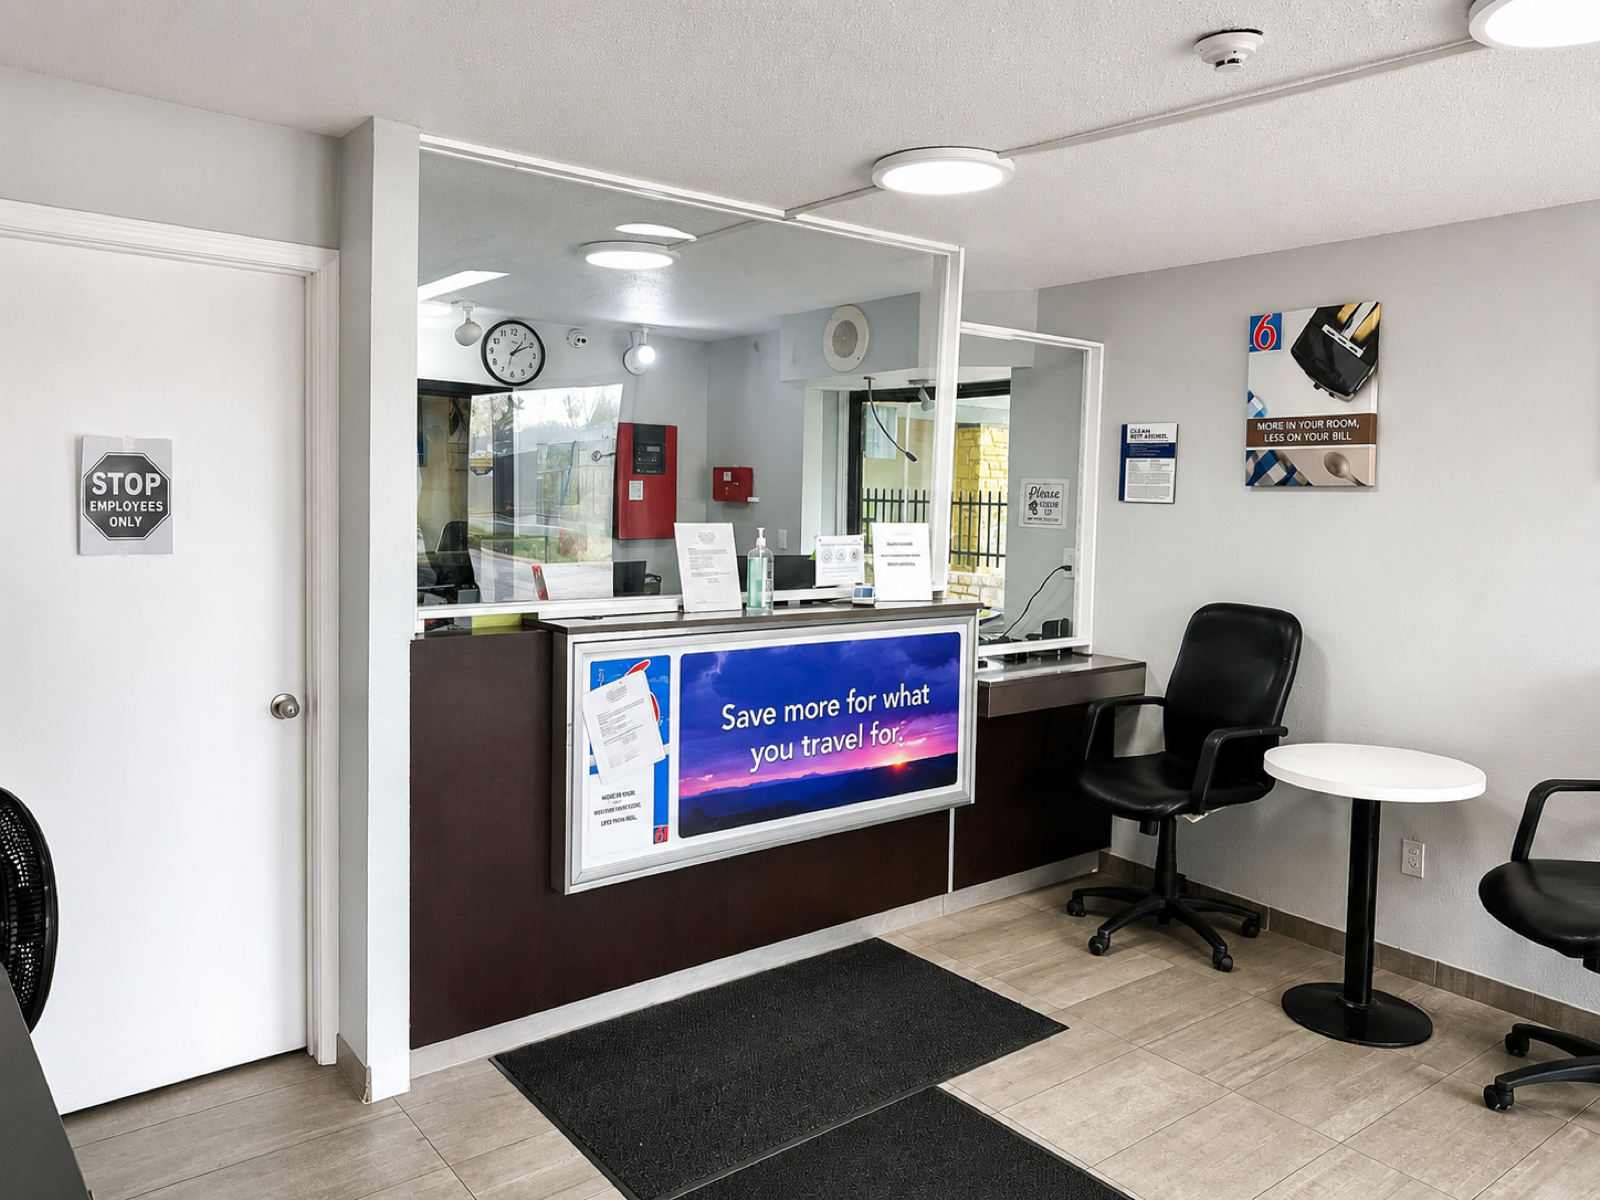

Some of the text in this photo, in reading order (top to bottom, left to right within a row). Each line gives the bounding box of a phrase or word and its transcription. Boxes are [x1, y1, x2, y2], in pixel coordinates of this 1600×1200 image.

[1253, 313, 1277, 351] 6
[1256, 418, 1360, 431] MORE IN YOUR ROOM,
[1264, 431, 1353, 443] LESS ON YOUR BILL
[91, 471, 161, 496] STOP
[89, 500, 164, 512] EMPLOYEES
[108, 516, 143, 528] ONLY
[721, 682, 930, 731] Save more for what
[749, 720, 904, 774] you travel for.
